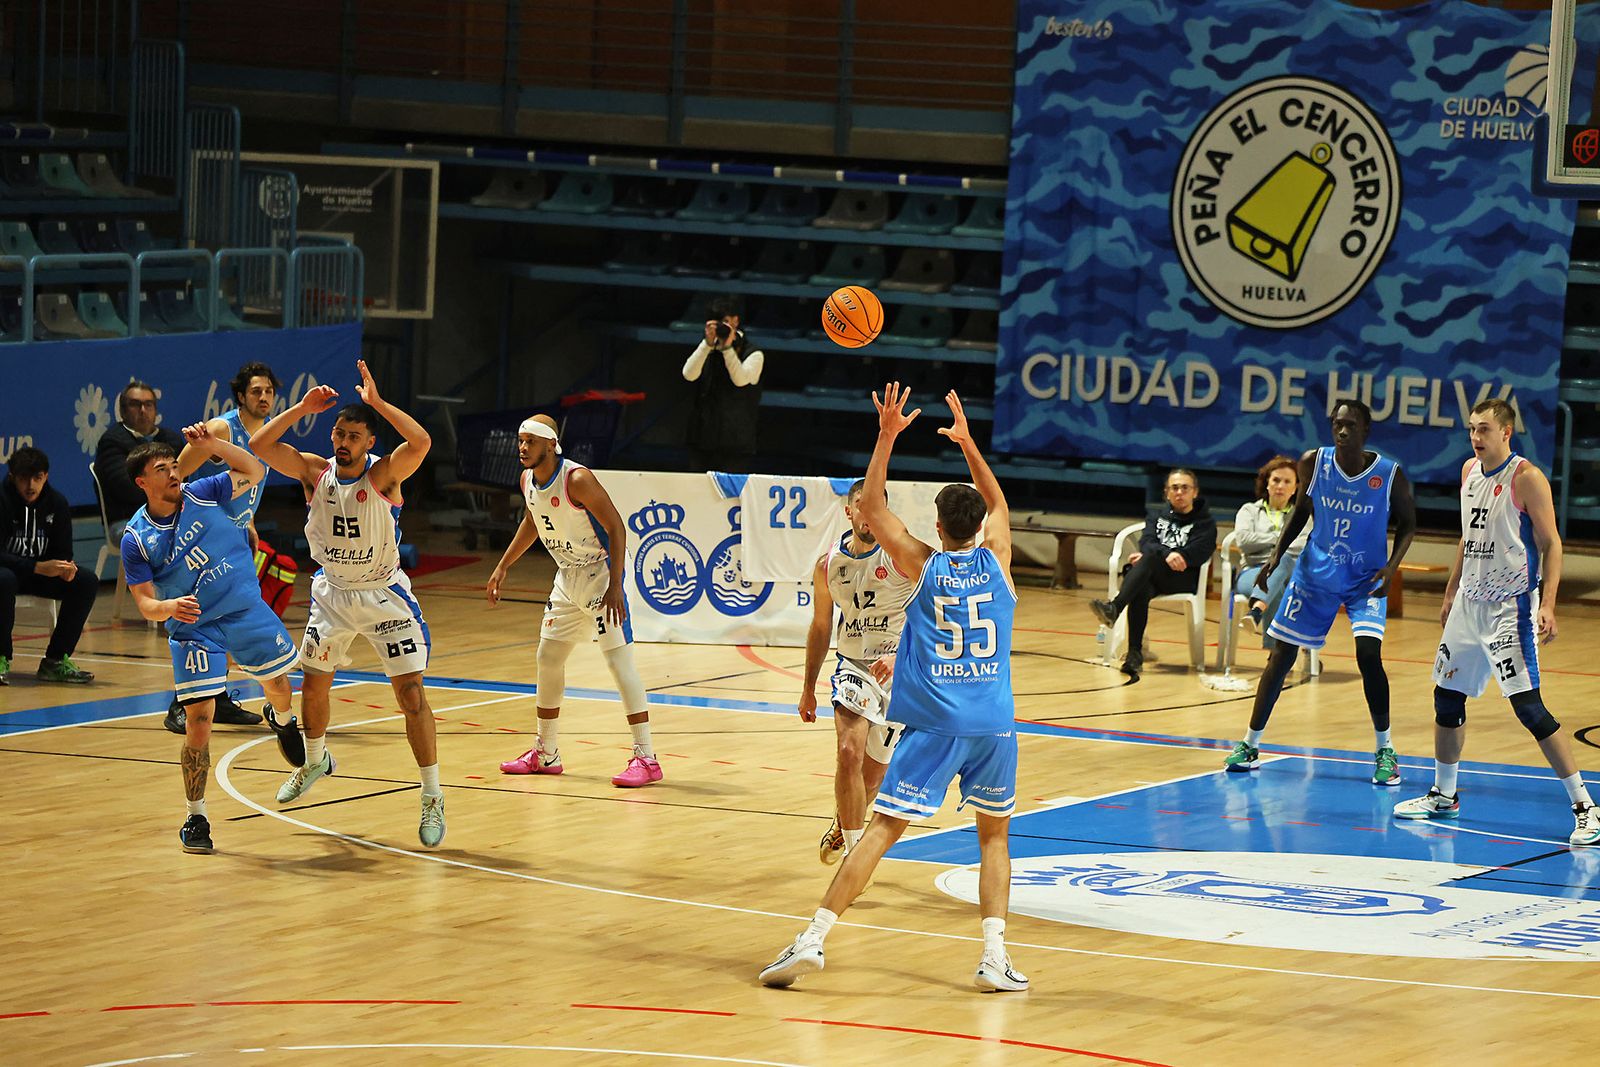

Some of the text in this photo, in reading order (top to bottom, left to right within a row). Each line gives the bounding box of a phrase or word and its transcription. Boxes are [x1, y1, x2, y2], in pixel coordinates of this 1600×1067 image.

[1443, 98, 1520, 117] CIUDAD
[1440, 120, 1466, 139] DE
[1193, 97, 1381, 261] PEÑA EL CENCERRO
[303, 184, 372, 197] Ayuntamiento
[322, 196, 373, 206] de Huelva
[1241, 283, 1307, 303] HUELVA
[1021, 352, 1220, 411] CIUDAD
[1240, 364, 1306, 415] DE
[768, 485, 807, 529] 22
[332, 515, 361, 539] 65
[541, 515, 555, 531] 3
[1333, 518, 1351, 538] 12
[1469, 507, 1489, 529] 23
[184, 546, 210, 571] 40
[324, 546, 374, 560] MELILLA
[935, 573, 991, 590] TREVIÑO
[853, 590, 876, 610] 12
[1283, 595, 1303, 622] 12
[596, 616, 607, 635] 3
[933, 593, 998, 660] 55
[386, 638, 418, 659] 65
[184, 649, 211, 674] 40
[883, 726, 906, 749] 1
